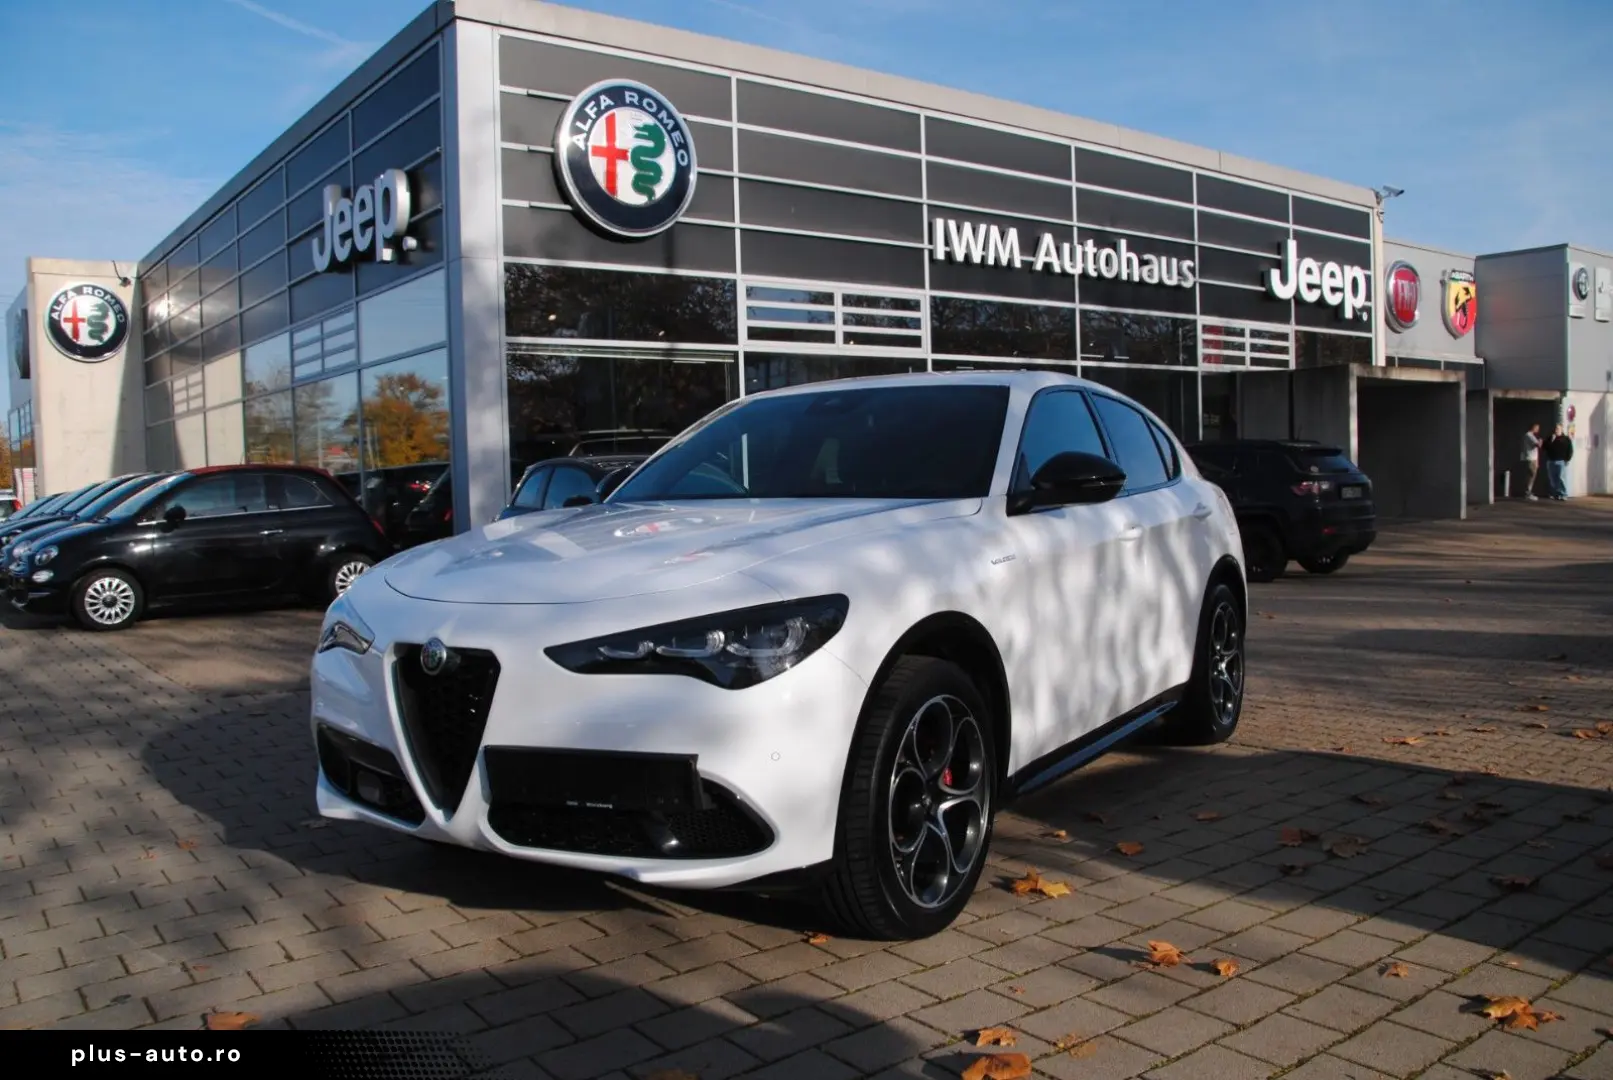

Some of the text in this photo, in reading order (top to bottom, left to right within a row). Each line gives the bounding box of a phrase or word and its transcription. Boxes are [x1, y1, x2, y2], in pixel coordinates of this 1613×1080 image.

[571, 90, 689, 167] ALFA ROMEO
[932, 217, 1195, 289] IWM Autohaus
[50, 286, 125, 324] ALFA ROMEO
